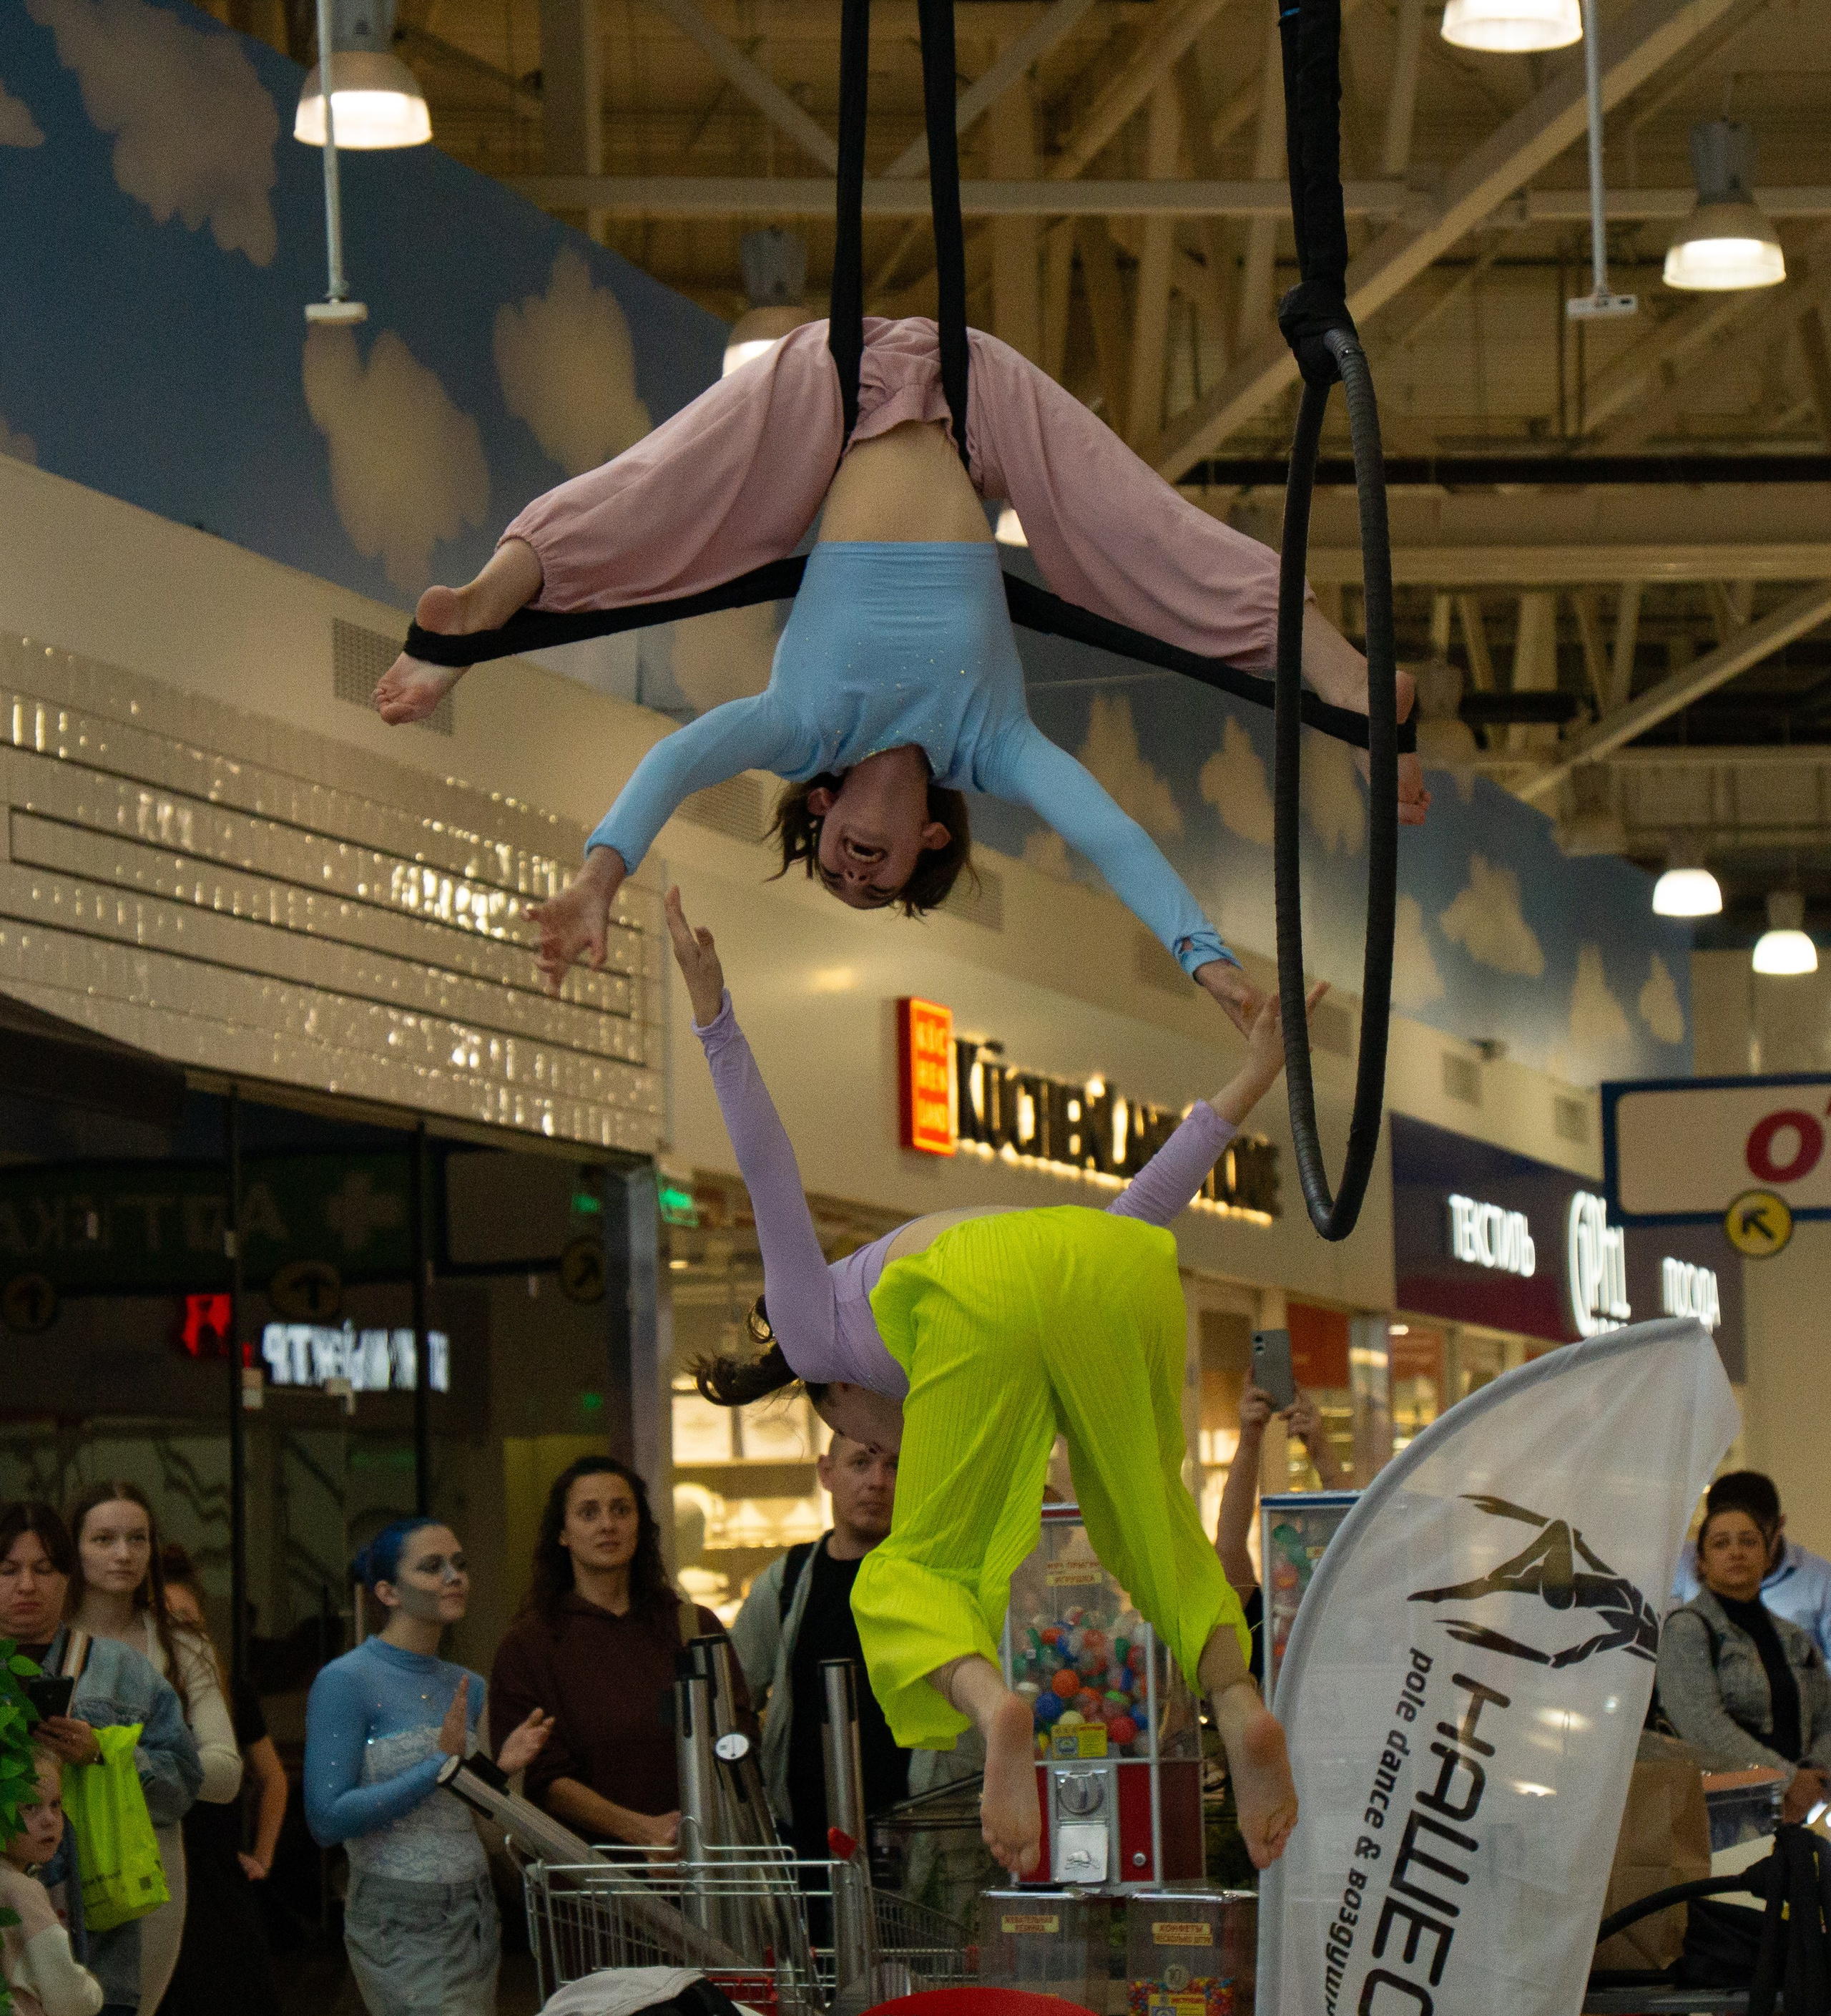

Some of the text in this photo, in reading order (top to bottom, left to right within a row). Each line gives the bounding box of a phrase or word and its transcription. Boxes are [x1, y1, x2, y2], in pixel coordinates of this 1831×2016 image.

[1395, 1648, 1433, 1723] pole
[1364, 1729, 1410, 1829] dance
[1354, 1836, 1381, 1861] &
